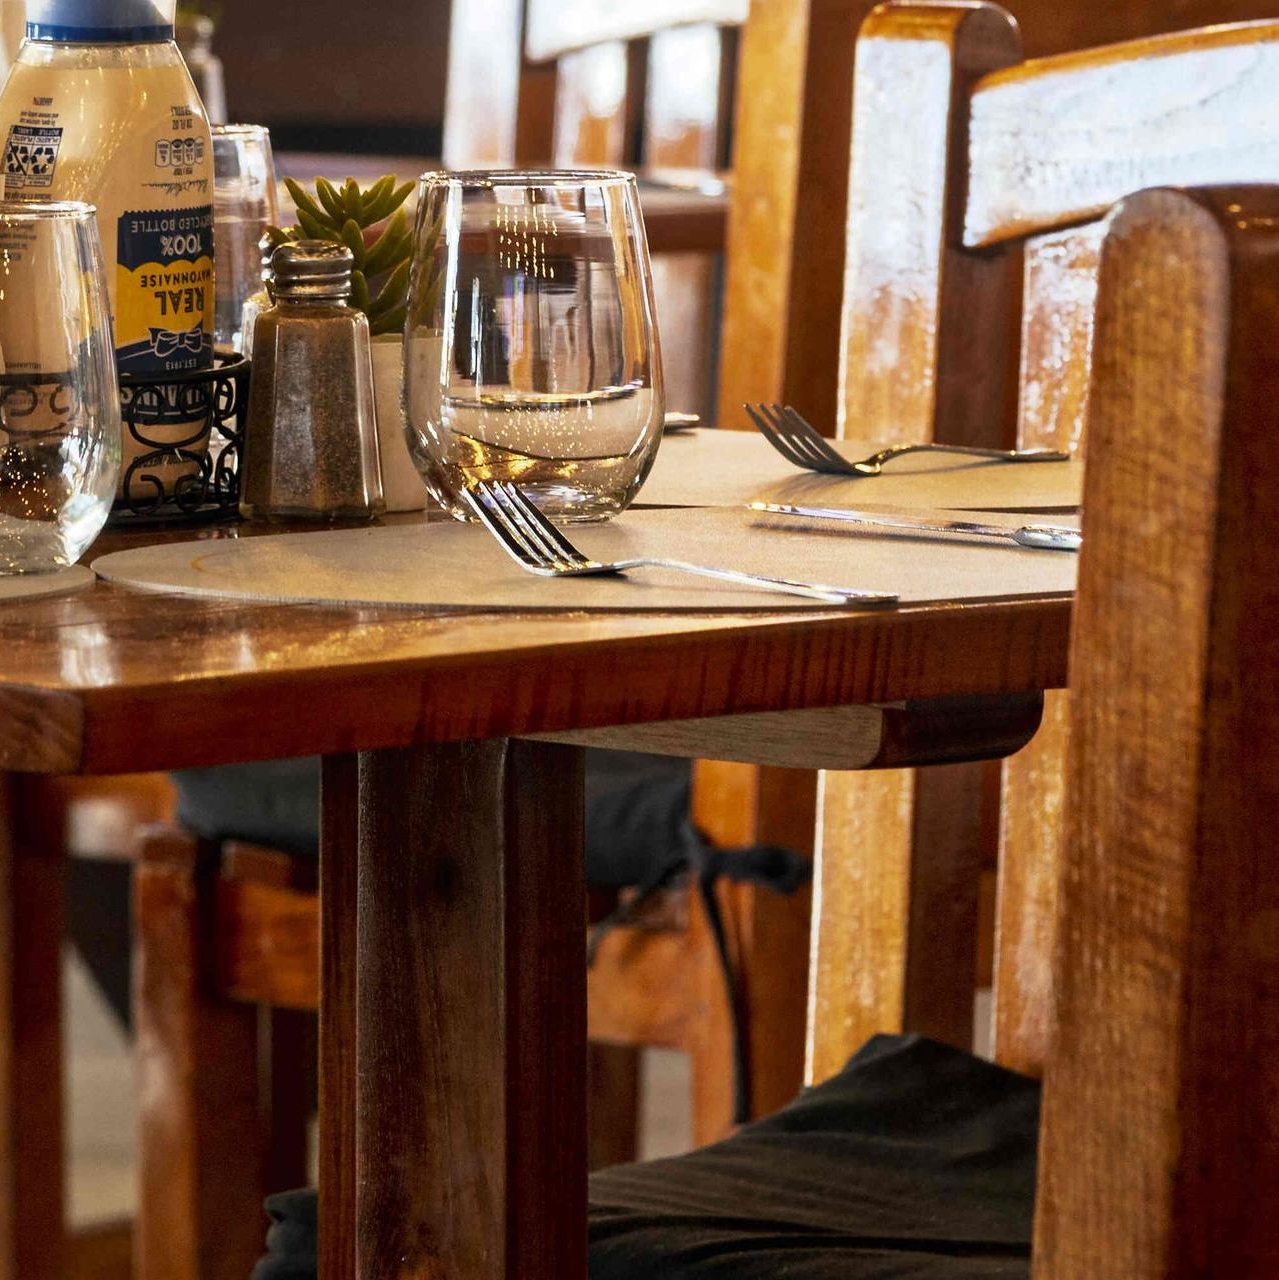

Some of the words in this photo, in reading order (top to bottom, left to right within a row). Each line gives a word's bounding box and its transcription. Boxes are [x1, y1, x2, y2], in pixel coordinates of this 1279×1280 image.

[131, 219, 175, 233] BOTTLE
[160, 233, 202, 256] 100%
[140, 269, 210, 287] MAYONNAISE
[154, 287, 204, 316] REAL
